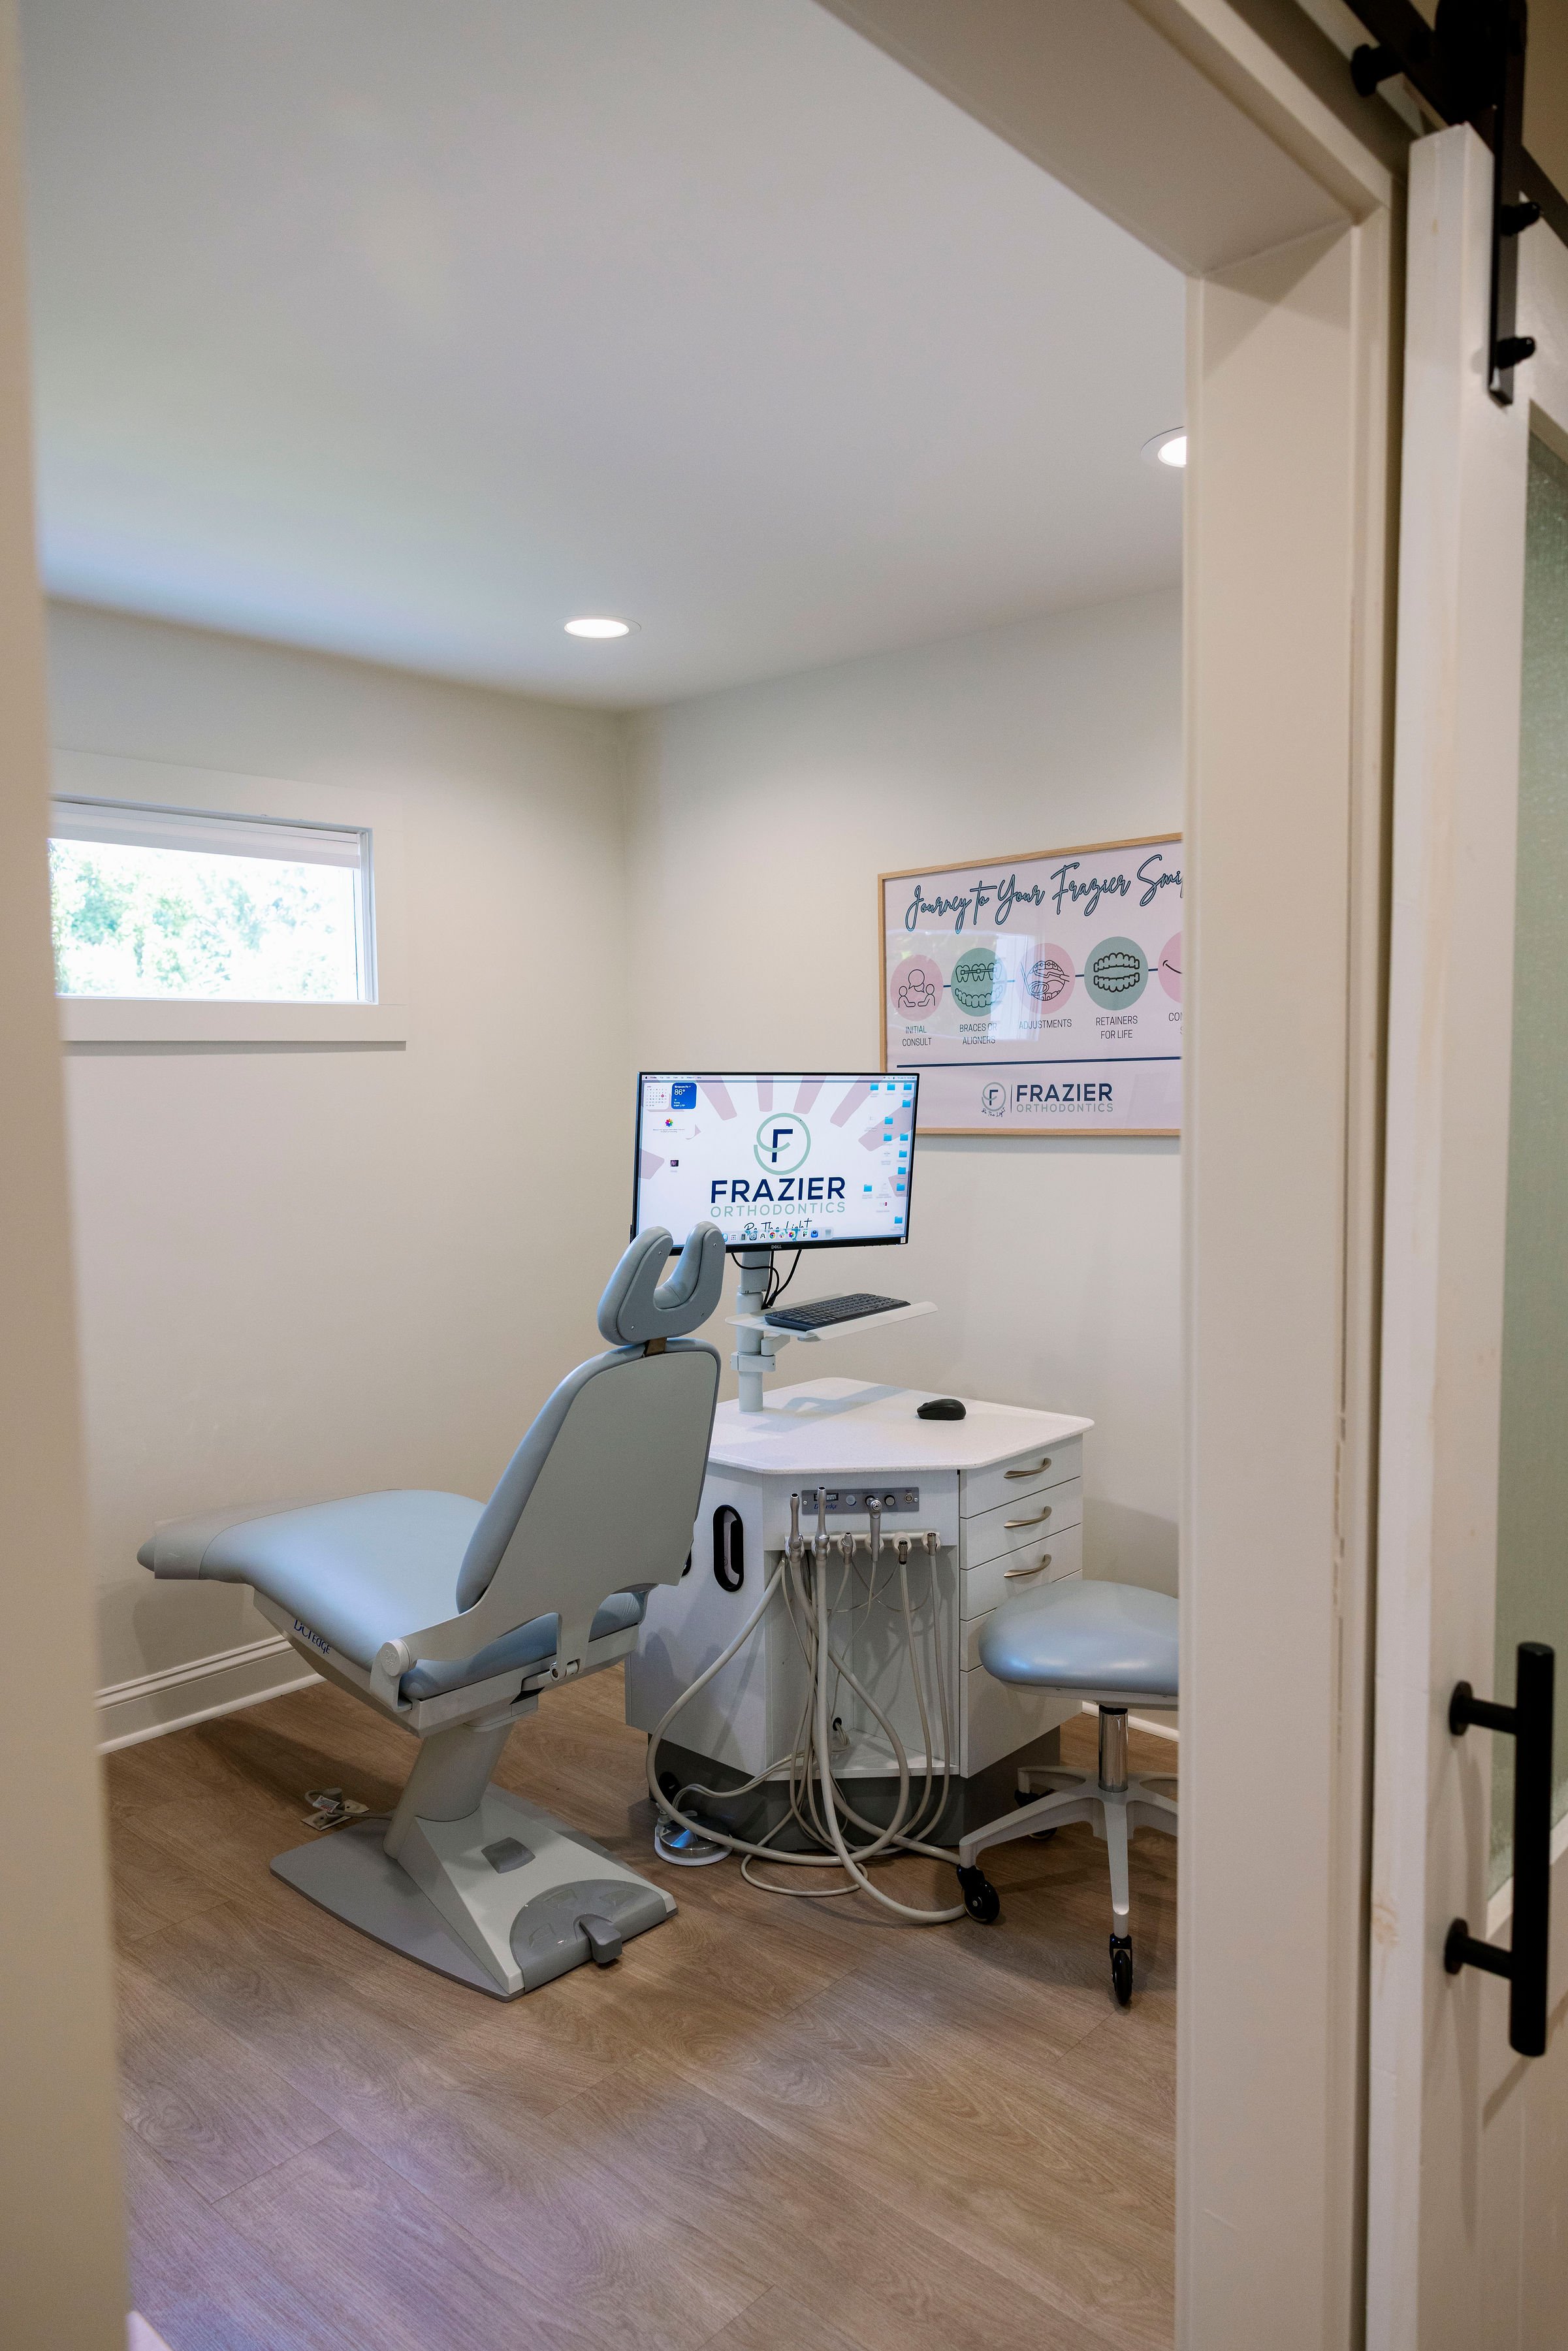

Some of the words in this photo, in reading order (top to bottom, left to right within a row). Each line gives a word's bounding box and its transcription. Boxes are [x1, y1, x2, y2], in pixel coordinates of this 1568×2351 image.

[905, 885, 972, 934] Journey
[970, 881, 997, 925] to
[995, 874, 1045, 925] Your
[1051, 862, 1131, 916] Frazier
[1137, 854, 1183, 906] Smi
[1019, 1019, 1072, 1029] ADJUSTMENTS
[1096, 1016, 1138, 1026] RETAINERS
[905, 1025, 927, 1034] INITIAL
[959, 1023, 986, 1032] BRACES
[987, 1022, 997, 1031] OR
[1100, 1031, 1115, 1039] FOR
[1117, 1029, 1133, 1038] LIFE
[902, 1037, 932, 1046] CONSULT
[963, 1035, 996, 1045] ALIGNERS
[1016, 1083, 1113, 1102] FRAZIER
[1017, 1103, 1113, 1112] ORTHODONTICS
[711, 1177, 846, 1203] FRAZIER
[711, 1202, 846, 1218] ORTHODONTICS
